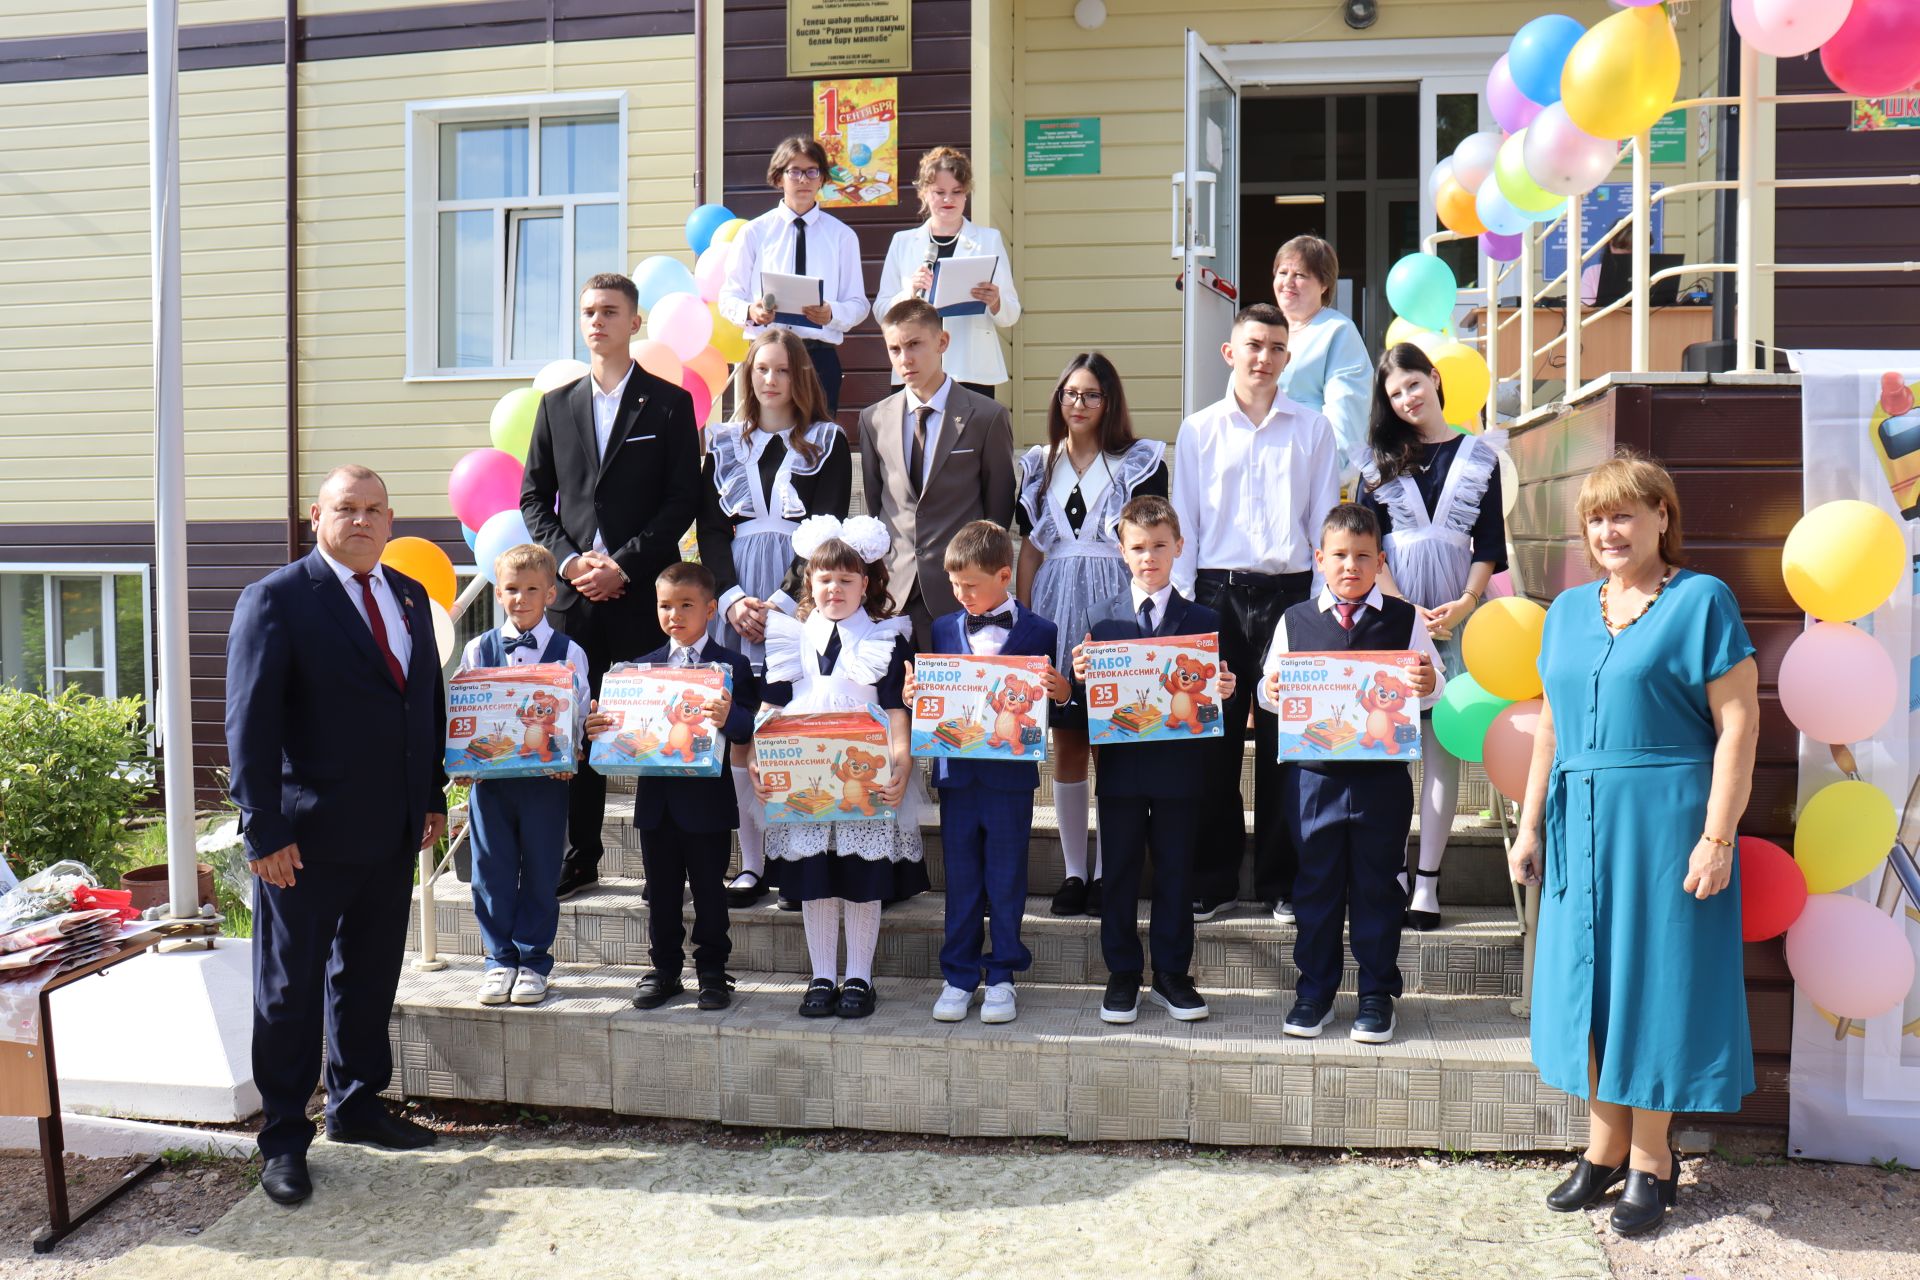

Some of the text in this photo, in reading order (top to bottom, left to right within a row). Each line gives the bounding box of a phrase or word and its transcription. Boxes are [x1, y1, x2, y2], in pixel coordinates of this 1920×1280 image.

[819, 88, 842, 137] 1
[839, 101, 893, 123] СЕНТЯБРЯ
[1885, 97, 1920, 117] ШК
[1087, 655, 1132, 670] НАБОР
[917, 670, 961, 682] НАБОР
[1087, 668, 1161, 679] ПЕРВОКЛАССНИКА
[1281, 669, 1328, 682] НАБОР
[603, 687, 643, 698] НАБОР
[1095, 686, 1112, 700] 35
[1280, 683, 1357, 691] ПЕРВОКЛАССНИКА
[450, 692, 493, 705] НАБОР
[922, 698, 939, 713] 35
[1288, 699, 1306, 714] 35
[455, 718, 471, 731] 35
[759, 747, 803, 760] НАБОР
[760, 758, 831, 767] ПЕРВОКЛАССНИКА
[768, 774, 786, 786] 35
